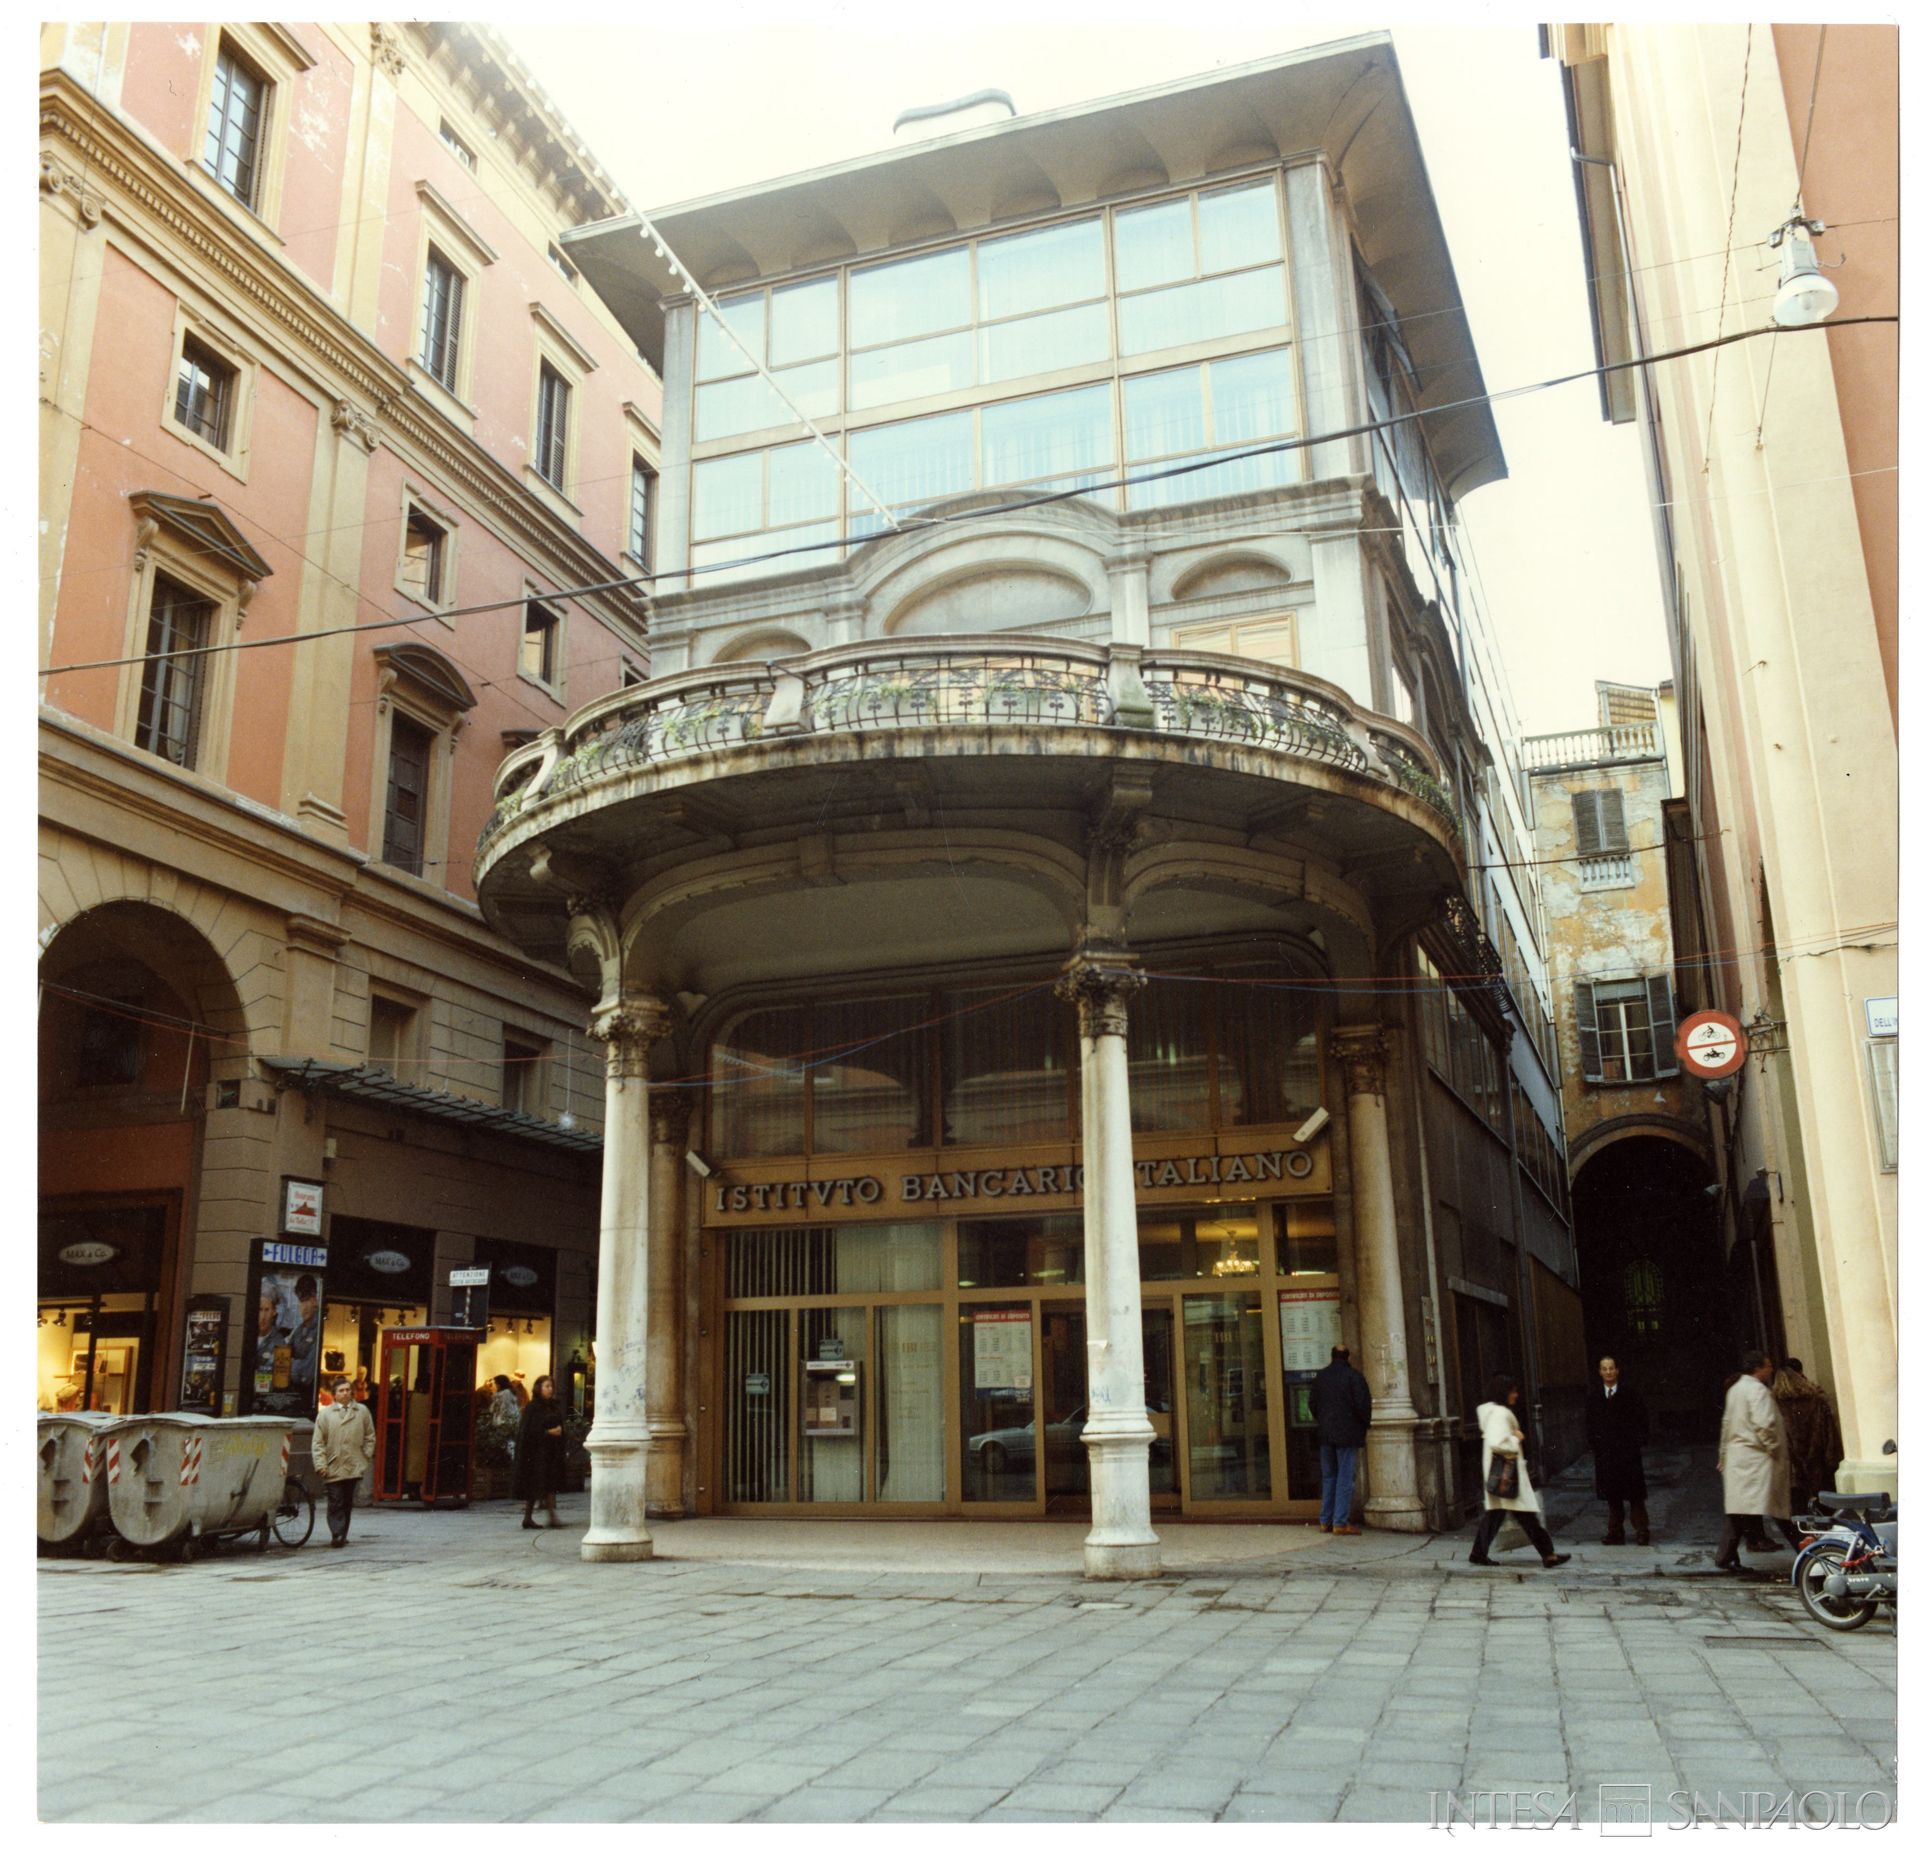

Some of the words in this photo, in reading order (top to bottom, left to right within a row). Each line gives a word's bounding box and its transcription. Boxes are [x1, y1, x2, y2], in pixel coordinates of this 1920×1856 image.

[716, 1176, 880, 1211] ISTITVTO
[1135, 1150, 1313, 1188] TALIANO
[452, 1271, 486, 1279] ATTENZIONE
[392, 1332, 430, 1340] TELEFONO
